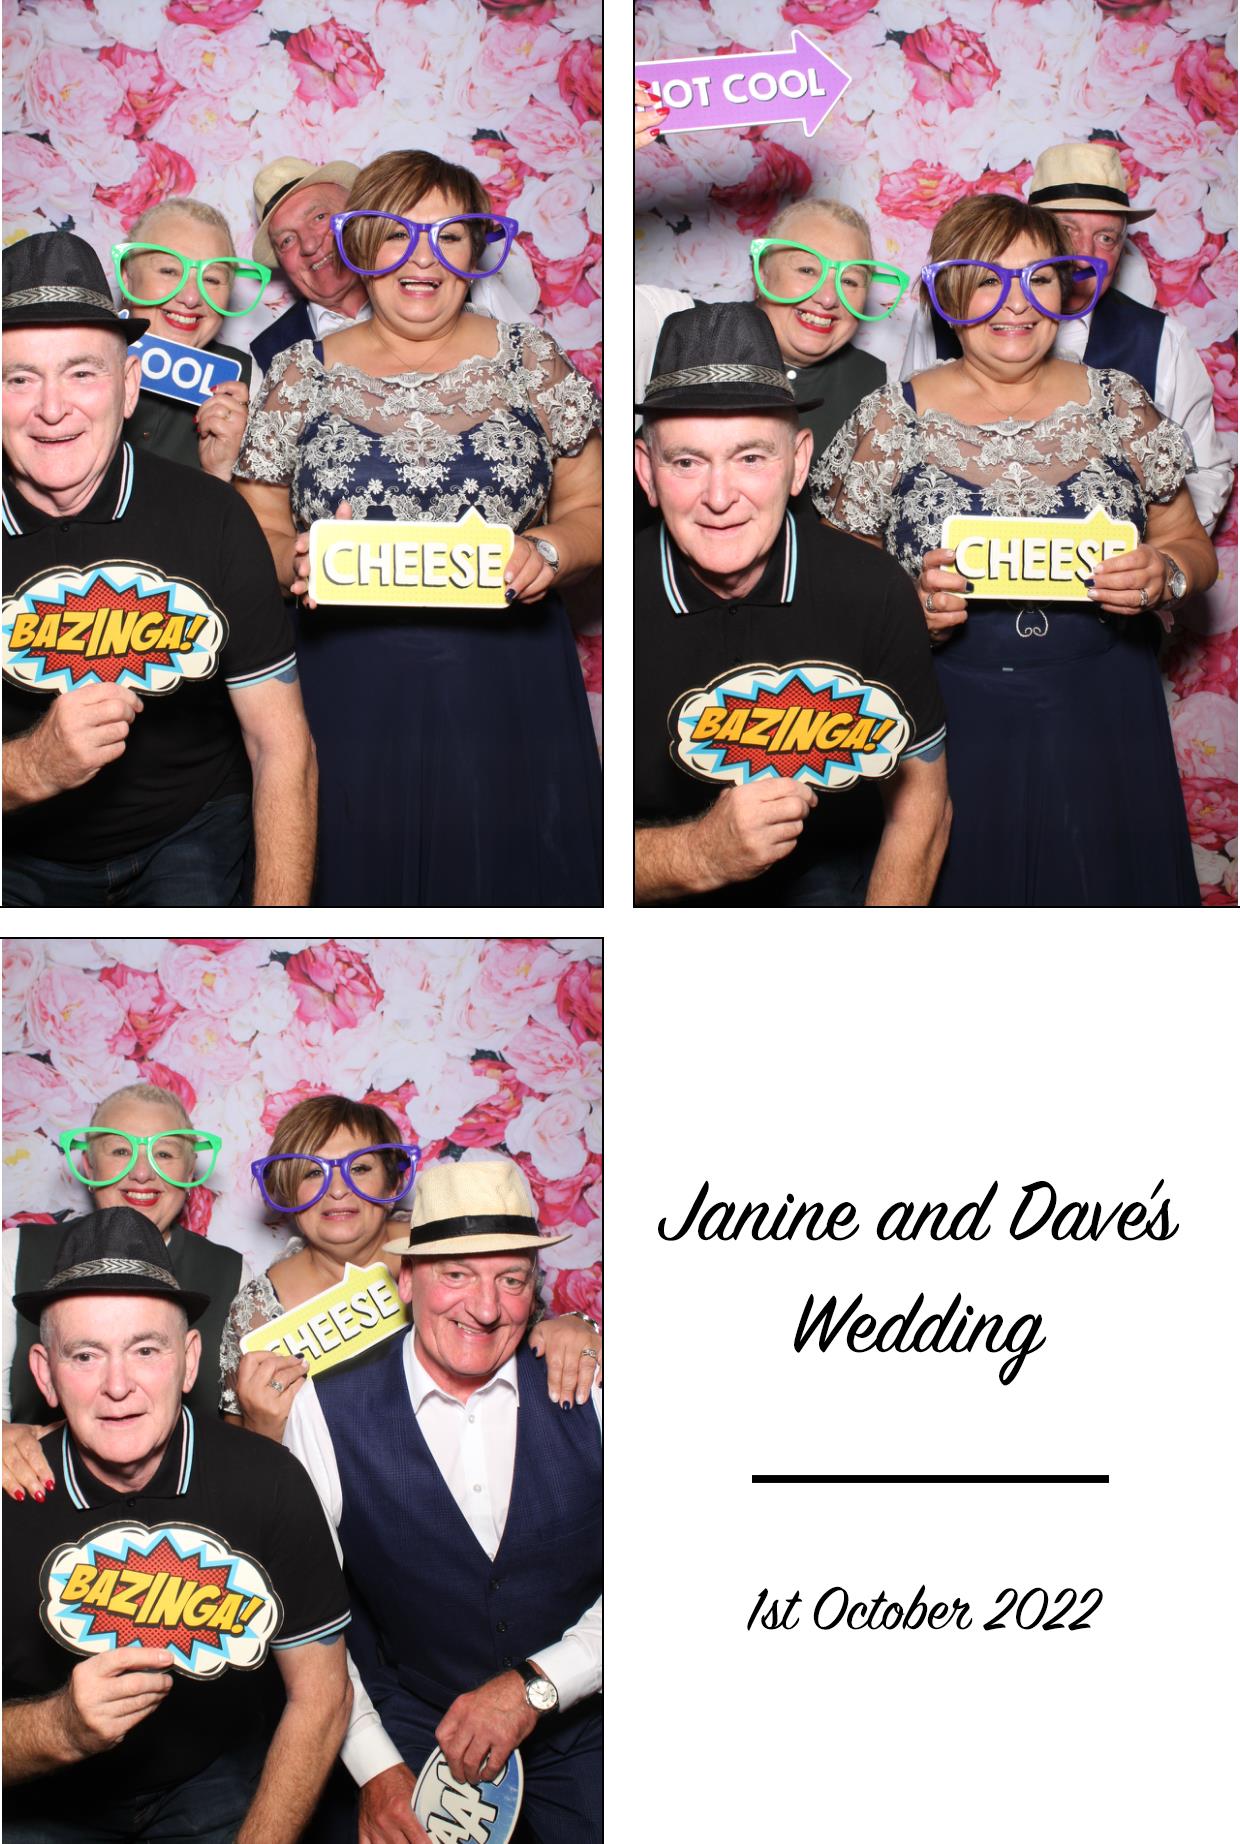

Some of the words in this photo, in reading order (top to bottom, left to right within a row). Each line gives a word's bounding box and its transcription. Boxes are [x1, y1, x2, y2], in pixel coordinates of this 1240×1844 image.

[722, 68, 826, 104] COOL
[131, 341, 214, 397] OOL
[323, 541, 503, 589] CHEESE
[8, 607, 209, 660] BAZINGA!
[690, 705, 898, 755] BAZINGA!
[60, 1563, 266, 1638] BAZINGA!
